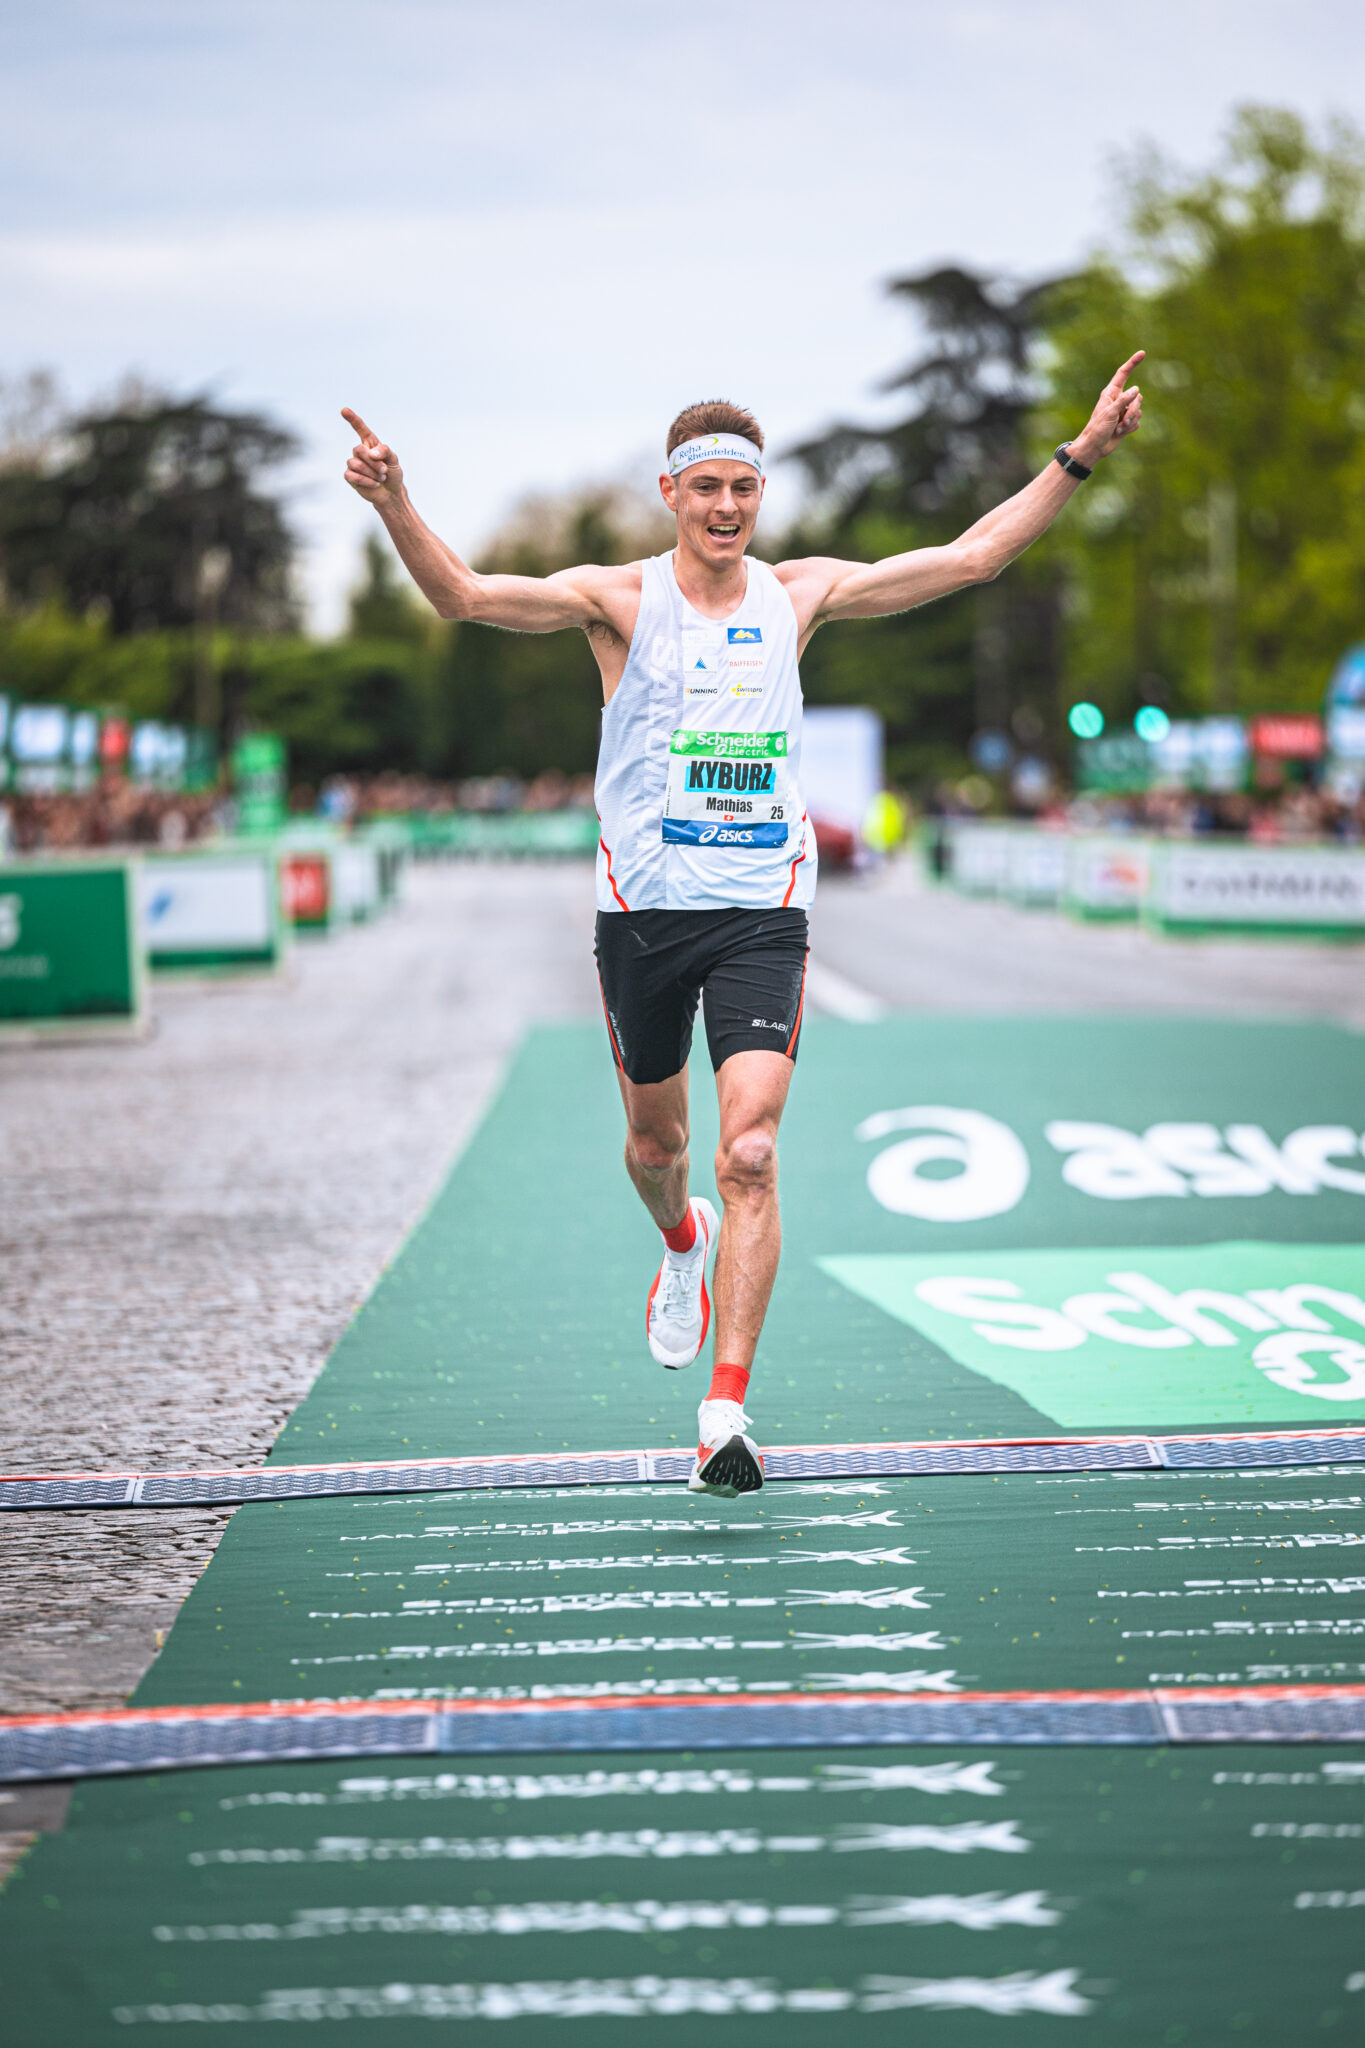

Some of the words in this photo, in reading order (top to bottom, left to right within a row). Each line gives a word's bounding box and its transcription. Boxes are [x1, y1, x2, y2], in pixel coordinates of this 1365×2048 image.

[679, 445, 701, 460] Reha
[687, 448, 746, 462] Rheinfelden
[729, 660, 764, 668] RAIFFEISEN
[696, 732, 771, 748] Schneider
[729, 746, 769, 756] Electric
[689, 760, 773, 792] KYBURZ
[706, 796, 753, 813] Mathias
[770, 805, 784, 820] 25
[1045, 1119, 1365, 1200] asic
